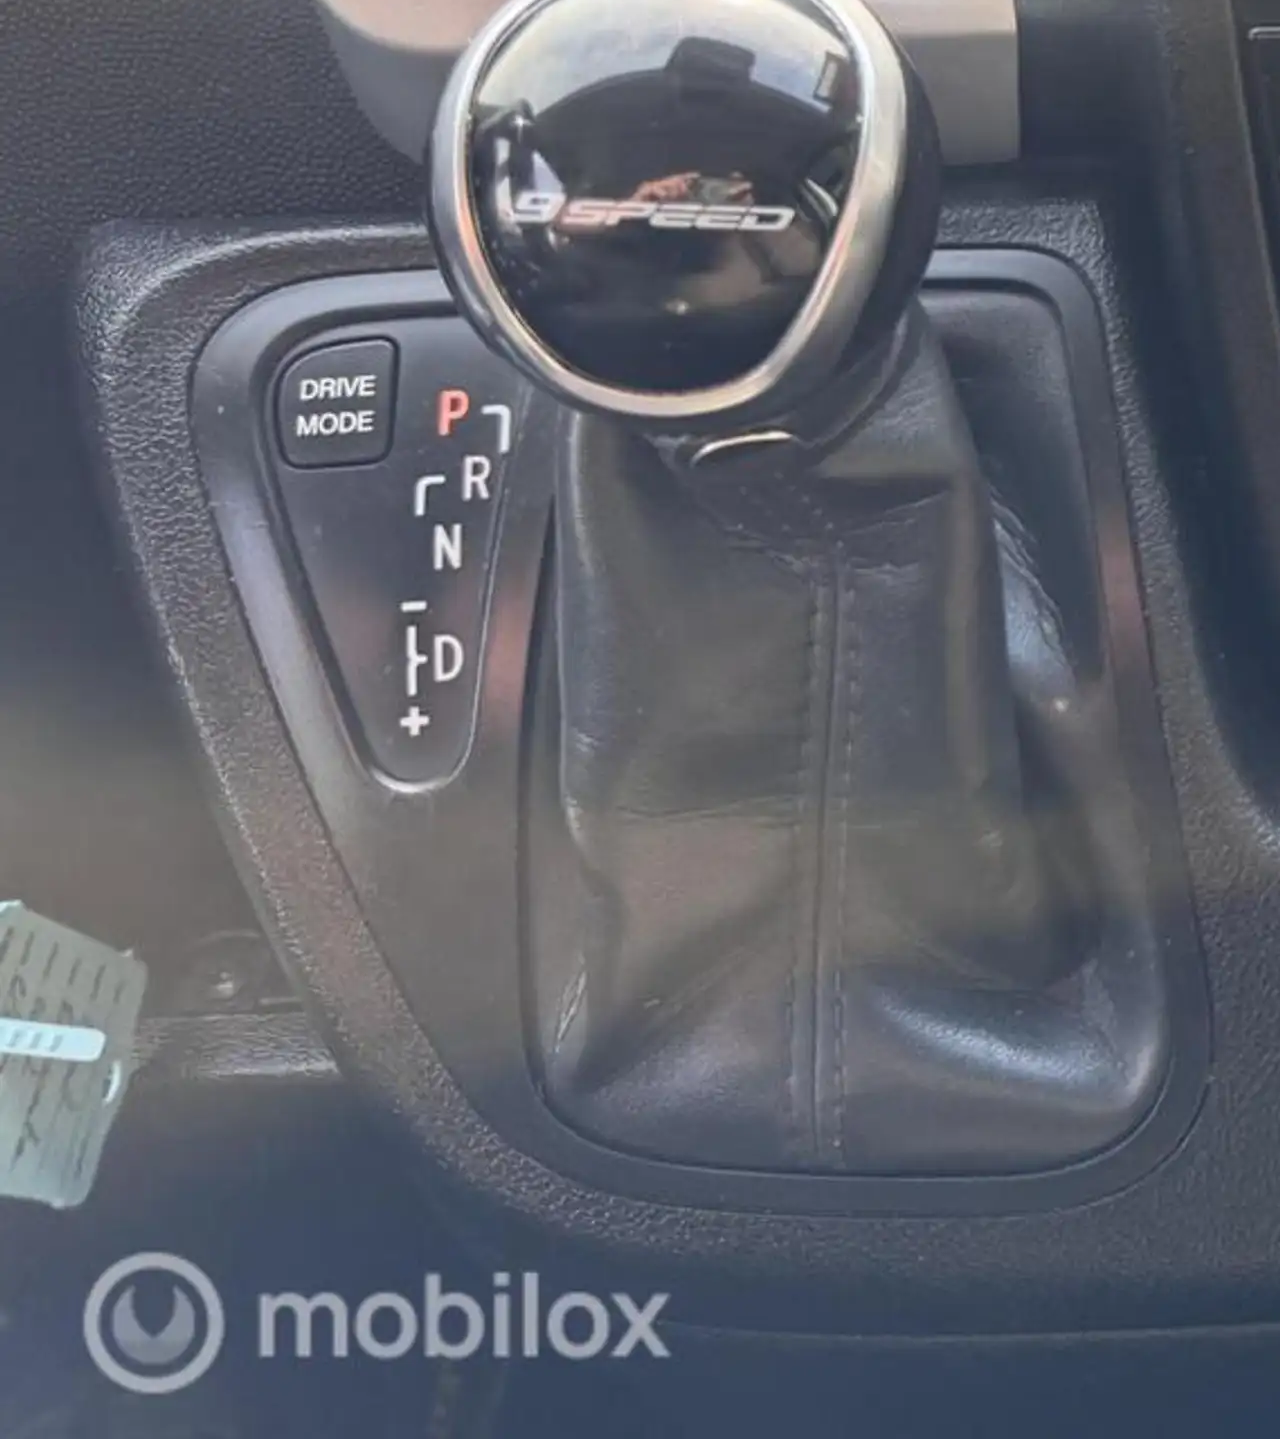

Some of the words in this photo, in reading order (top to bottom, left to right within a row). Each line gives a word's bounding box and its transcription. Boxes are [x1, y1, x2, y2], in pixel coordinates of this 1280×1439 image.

[514, 192, 565, 222] 9
[560, 199, 795, 230] SPEED
[299, 375, 376, 400] DRIVE
[295, 410, 375, 437] MODE
[437, 390, 470, 437] P
[461, 456, 490, 501] R
[433, 523, 462, 571] N
[433, 634, 464, 683] D
